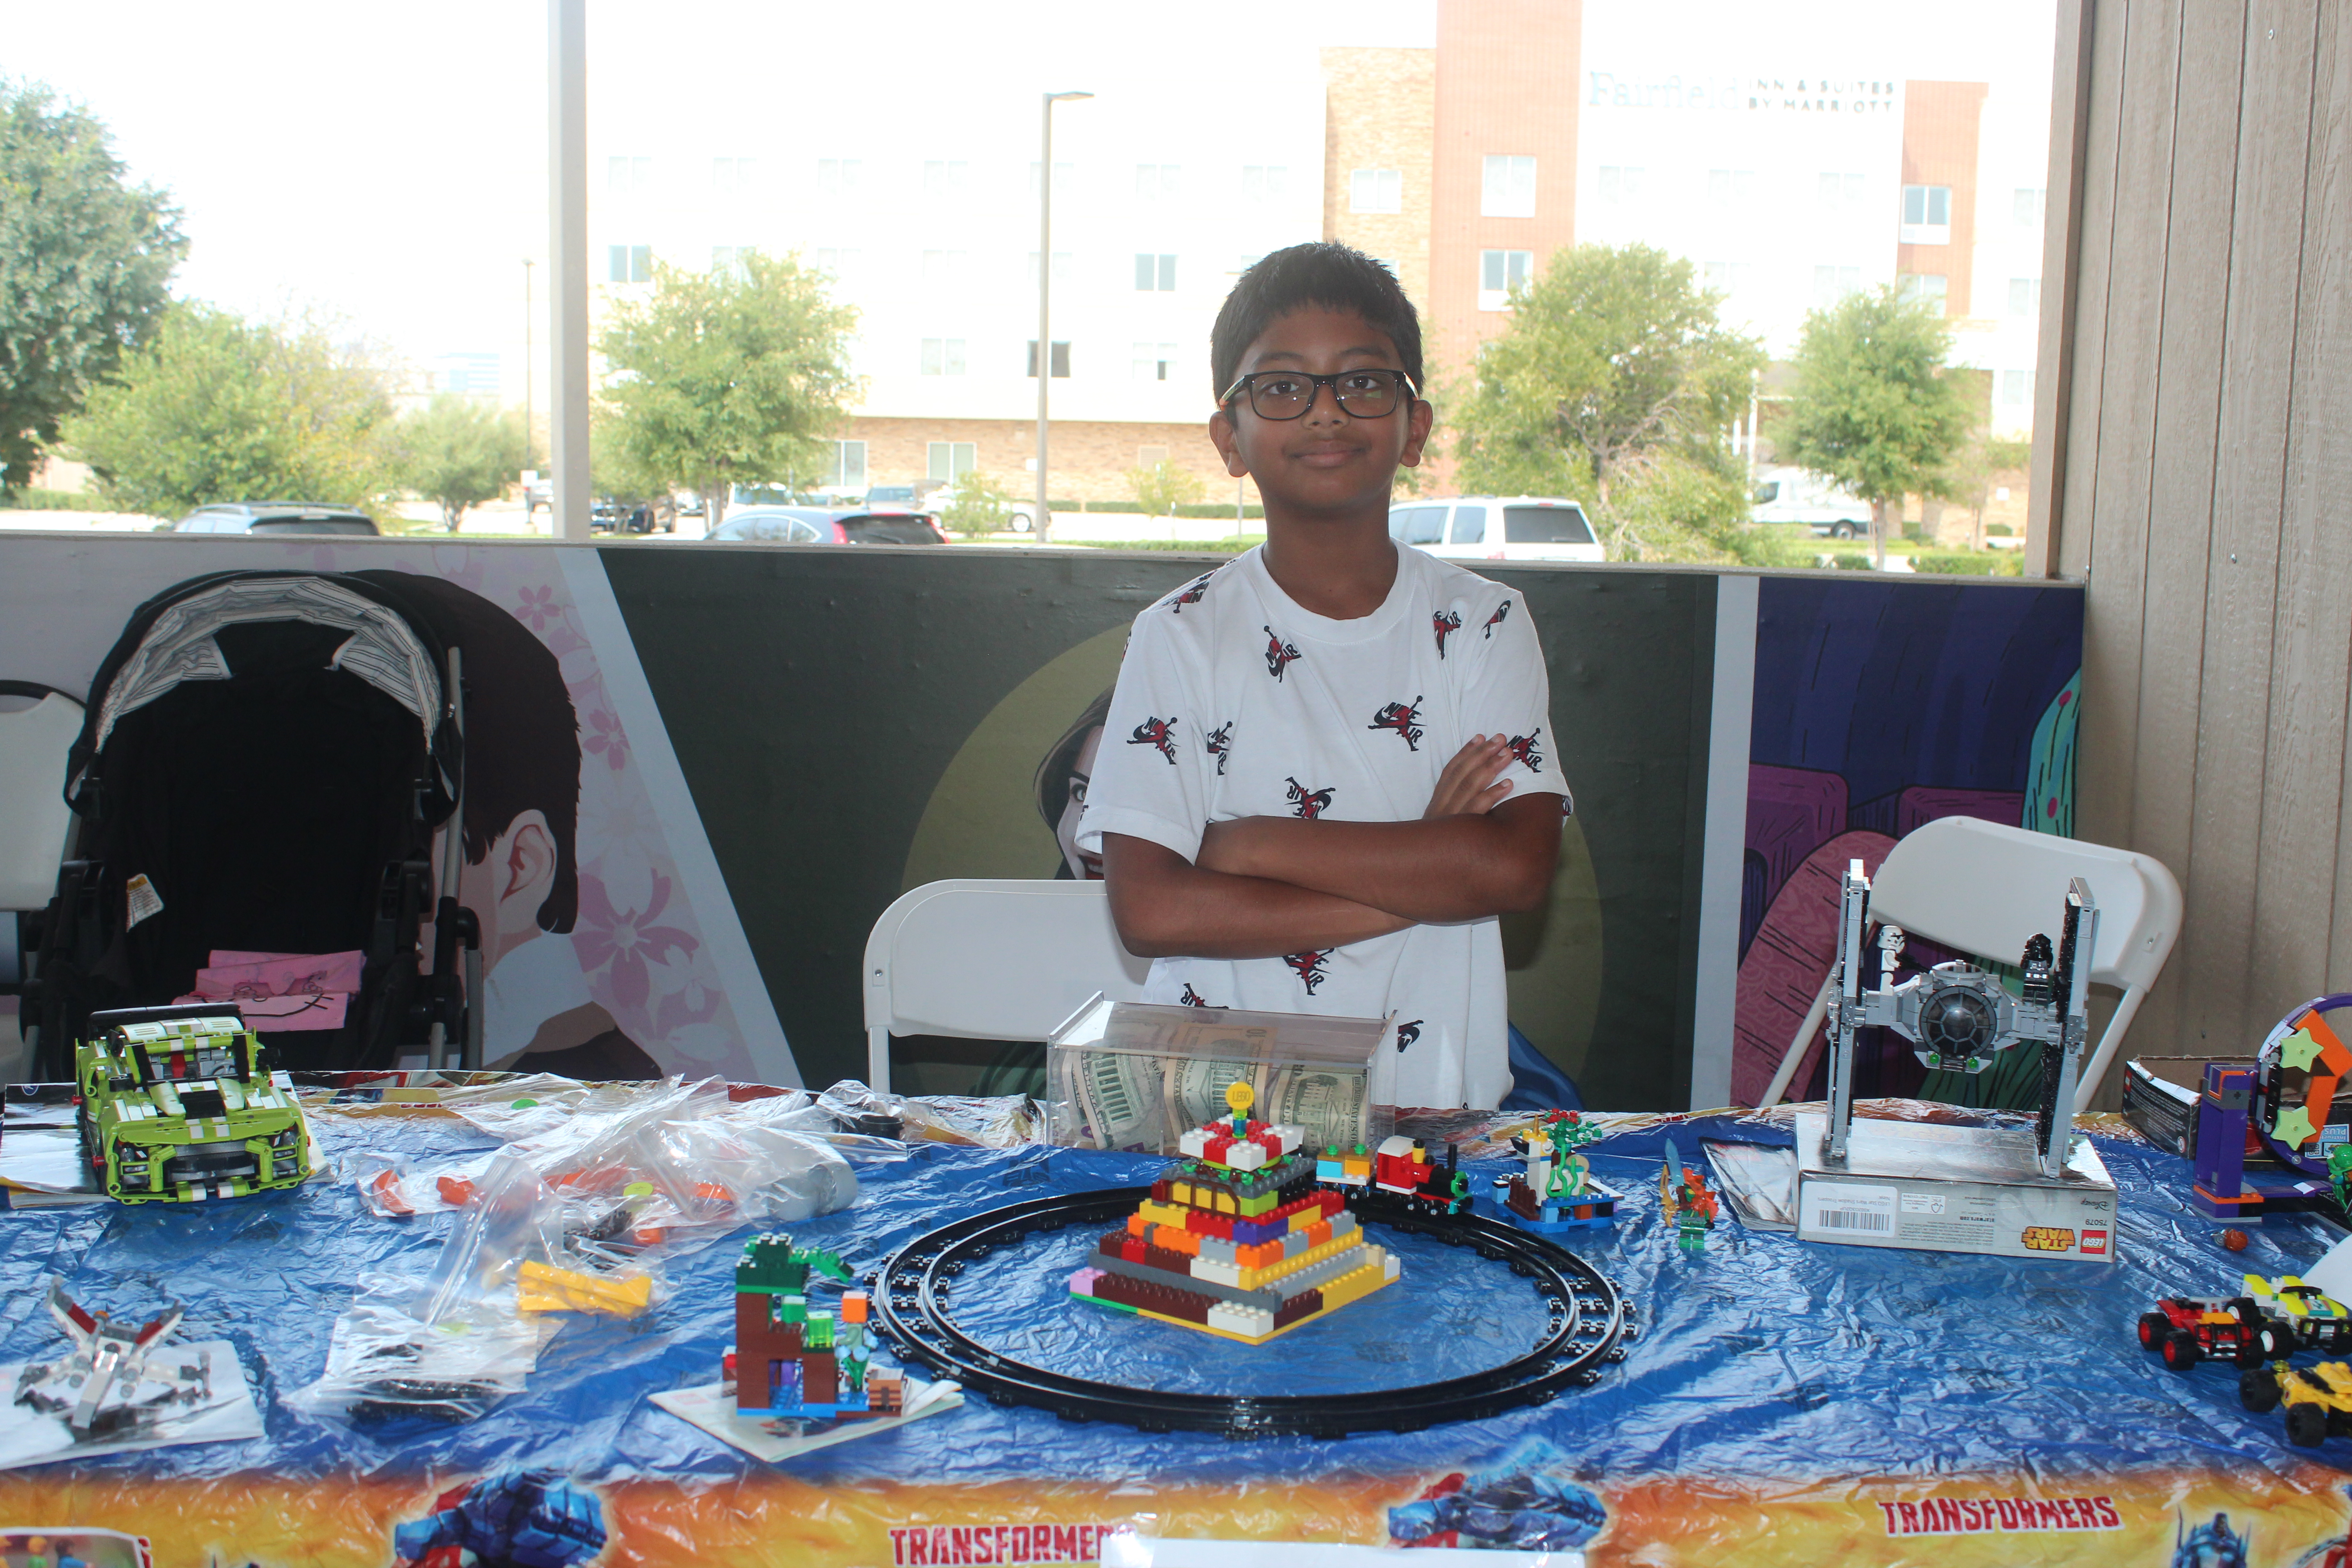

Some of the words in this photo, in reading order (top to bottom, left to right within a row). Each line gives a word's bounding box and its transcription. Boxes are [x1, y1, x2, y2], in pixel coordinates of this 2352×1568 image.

[1589, 70, 1739, 109] Fairfield
[1749, 78, 1785, 90] INN
[1820, 81, 1894, 95] SUITES
[1748, 97, 1772, 110] BY
[1784, 98, 1892, 113] MARRIOTT
[1349, 1102, 1359, 1132] STATES
[2021, 1227, 2075, 1240] WARS
[2021, 1237, 2075, 1252] STAR
[2082, 1237, 2106, 1248] LEGO
[1877, 1496, 2121, 1534] TRANSFORMERS
[889, 1524, 1135, 1566] TRANSFORME
